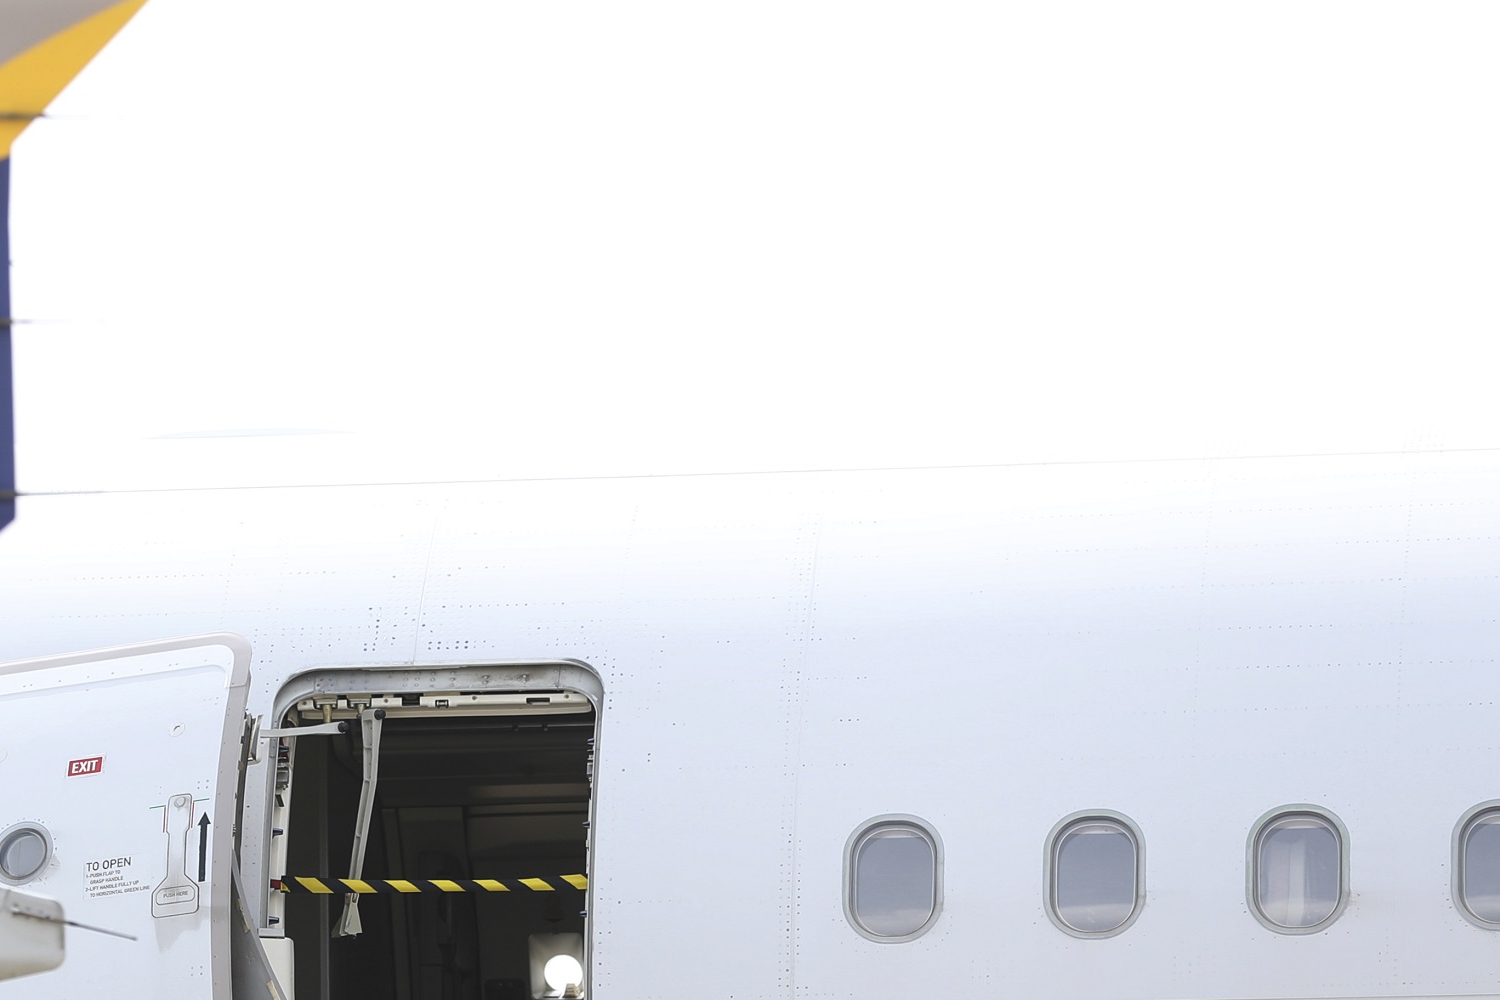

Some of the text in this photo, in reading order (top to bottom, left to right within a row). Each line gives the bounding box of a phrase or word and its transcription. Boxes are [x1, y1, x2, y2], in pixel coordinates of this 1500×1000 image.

[72, 760, 98, 773] EXIT
[86, 856, 131, 871] TO OPEN
